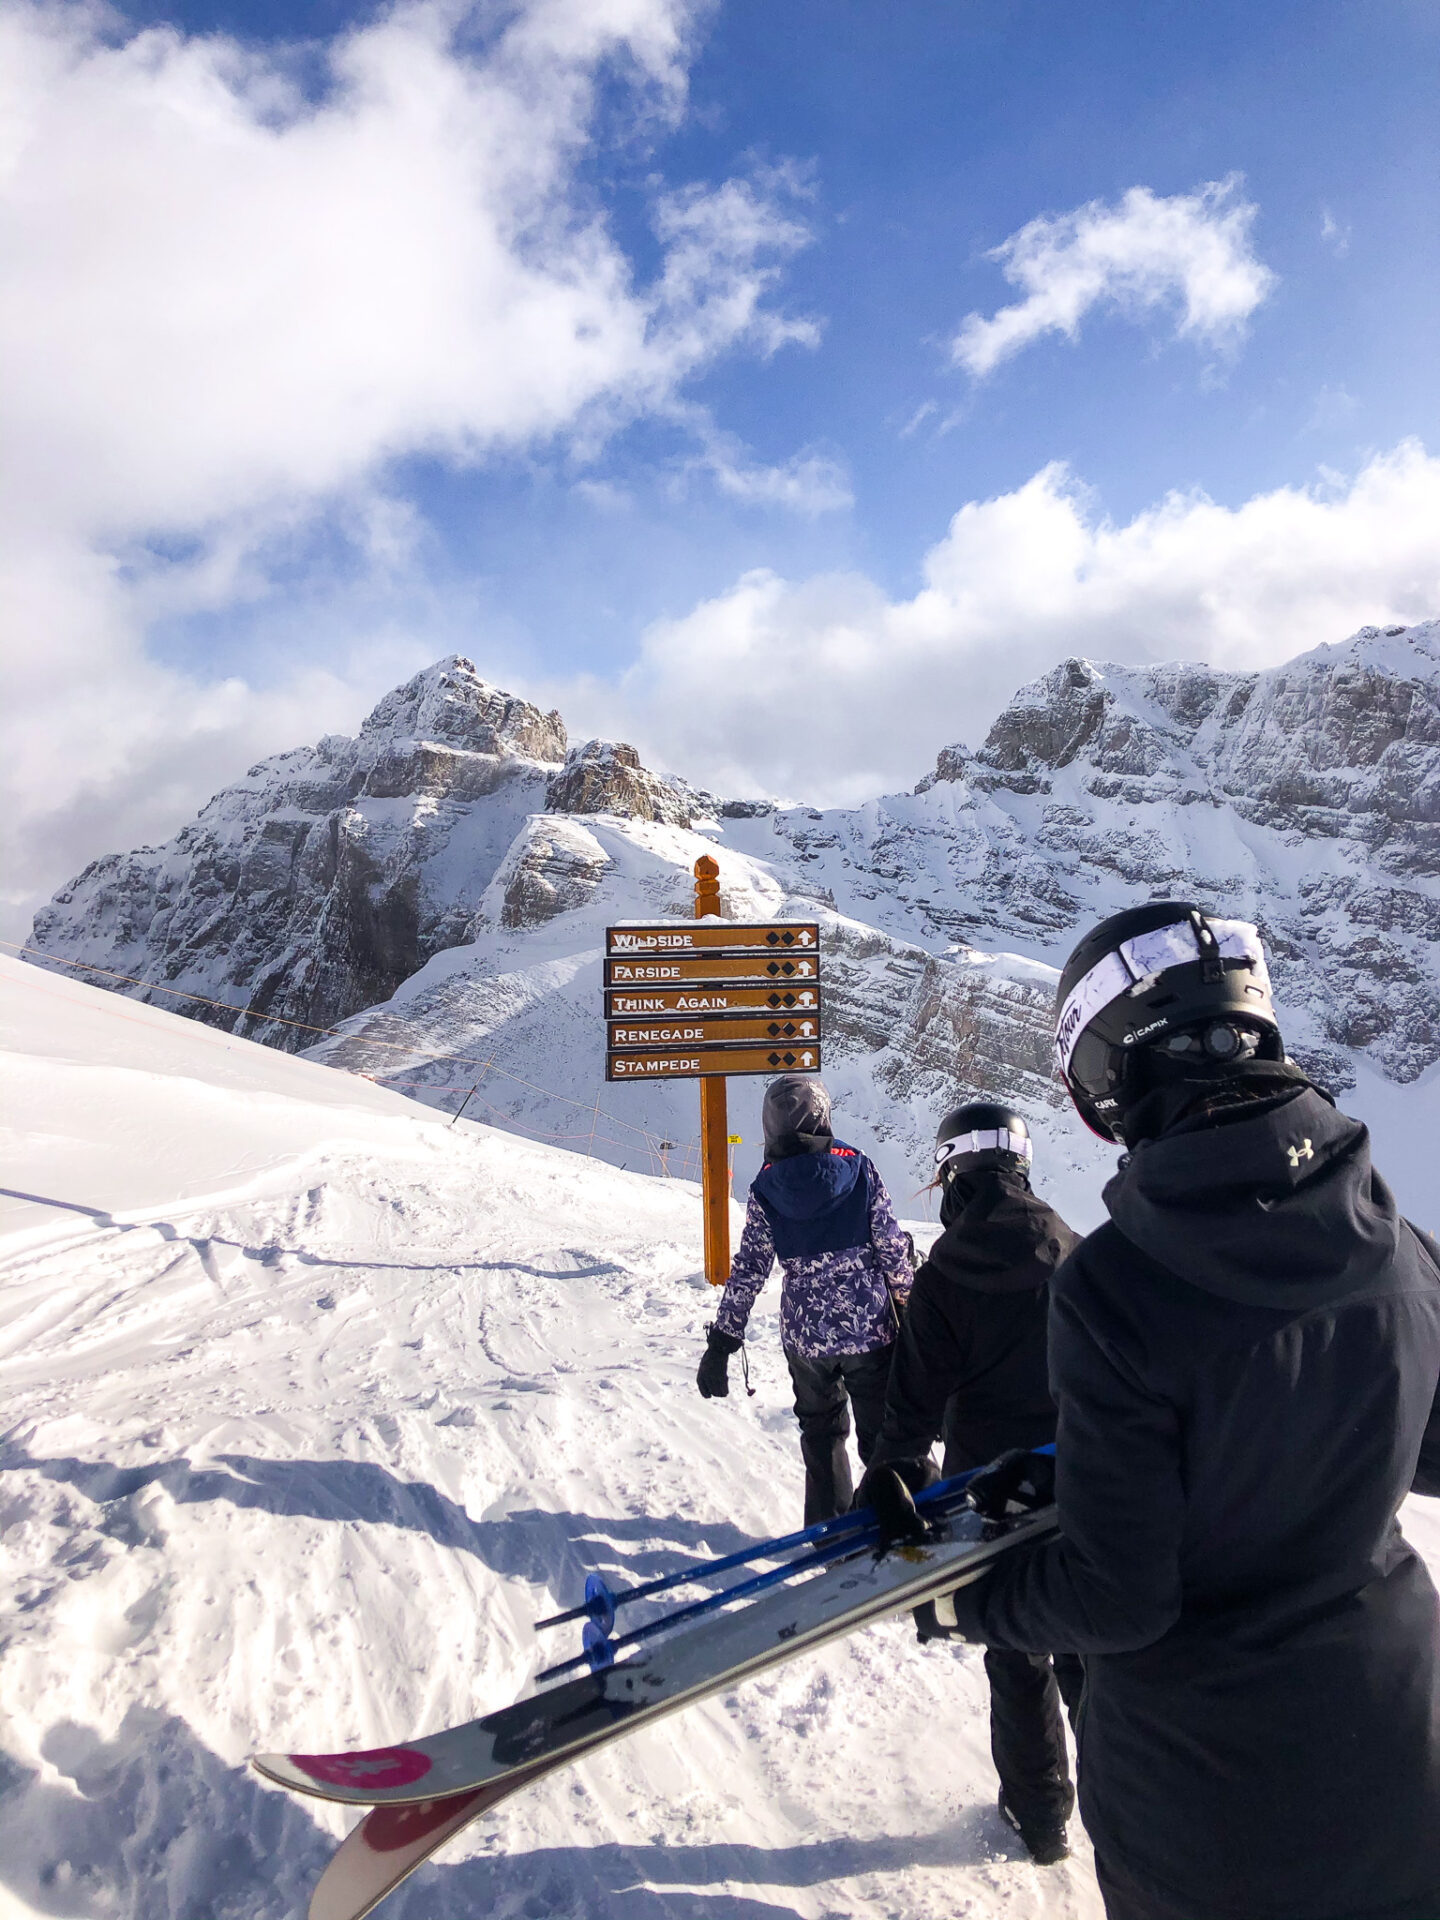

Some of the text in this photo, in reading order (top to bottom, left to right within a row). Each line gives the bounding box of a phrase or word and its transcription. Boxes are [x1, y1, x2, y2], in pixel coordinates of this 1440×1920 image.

[613, 934, 693, 947] WILDSIDE
[614, 966, 680, 978] FARSIDE
[614, 997, 727, 1010] THINK AGAIN
[1136, 1017, 1168, 1036] CAPIX
[615, 1028, 704, 1041] RENEGADE
[614, 1059, 700, 1072] STAMPEDE
